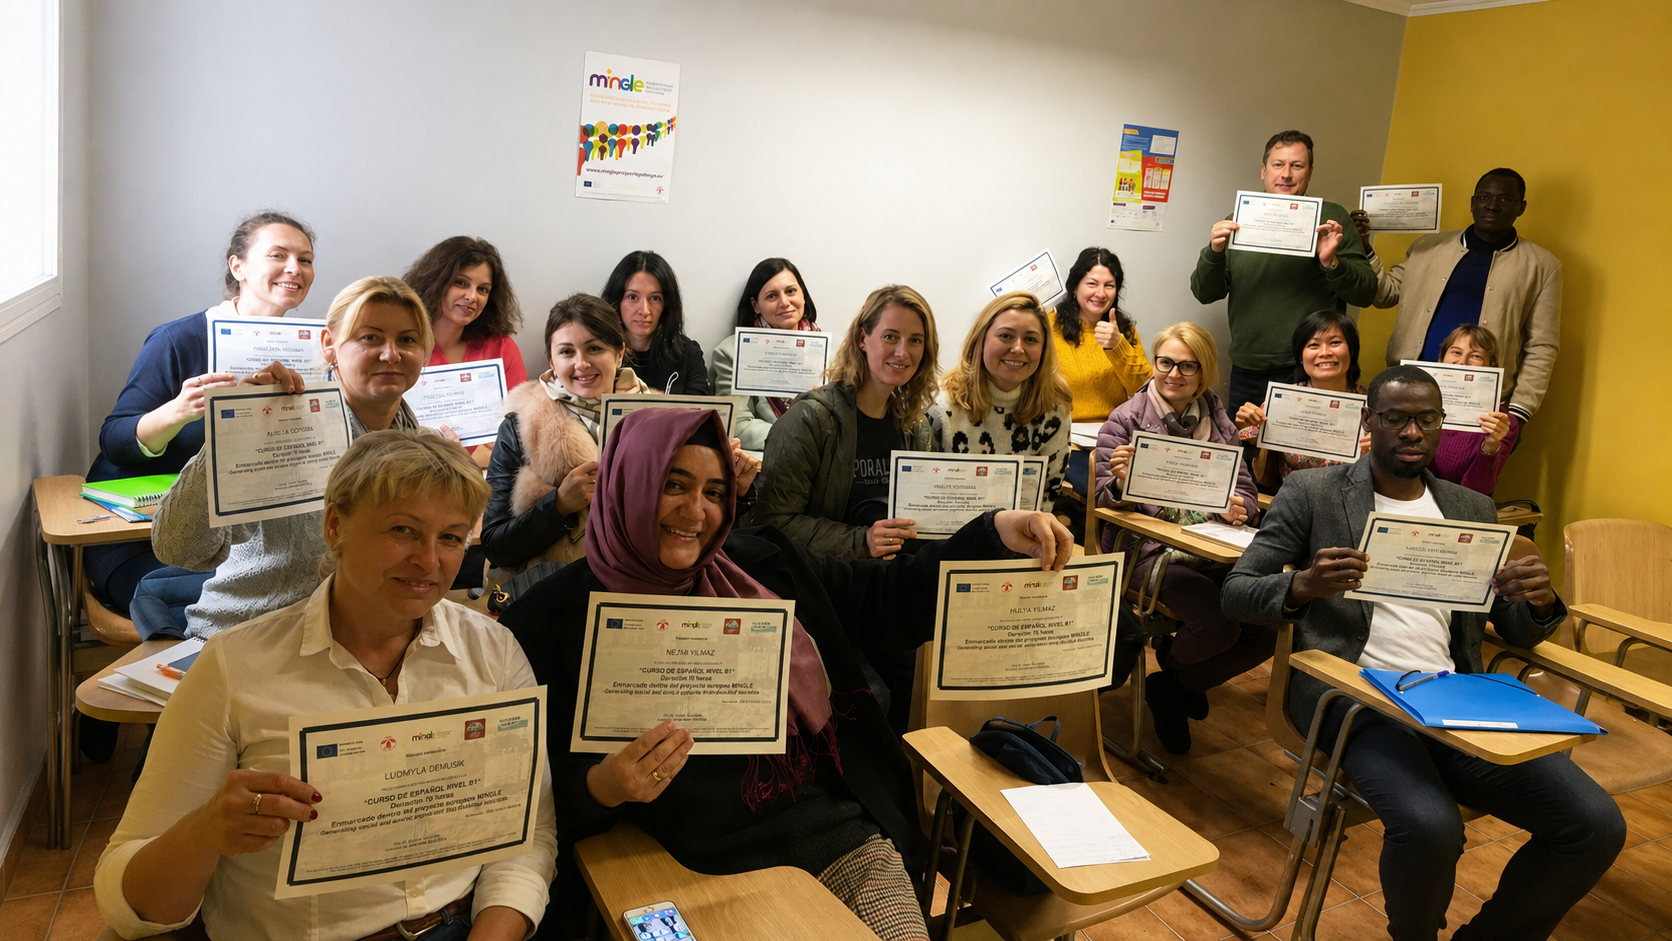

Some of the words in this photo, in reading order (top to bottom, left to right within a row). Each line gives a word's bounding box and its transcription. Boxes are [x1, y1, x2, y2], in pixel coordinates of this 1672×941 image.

[589, 68, 645, 93] mingle
[384, 766, 427, 781] LUDMYLA
[429, 759, 465, 773] DEMUSIK
